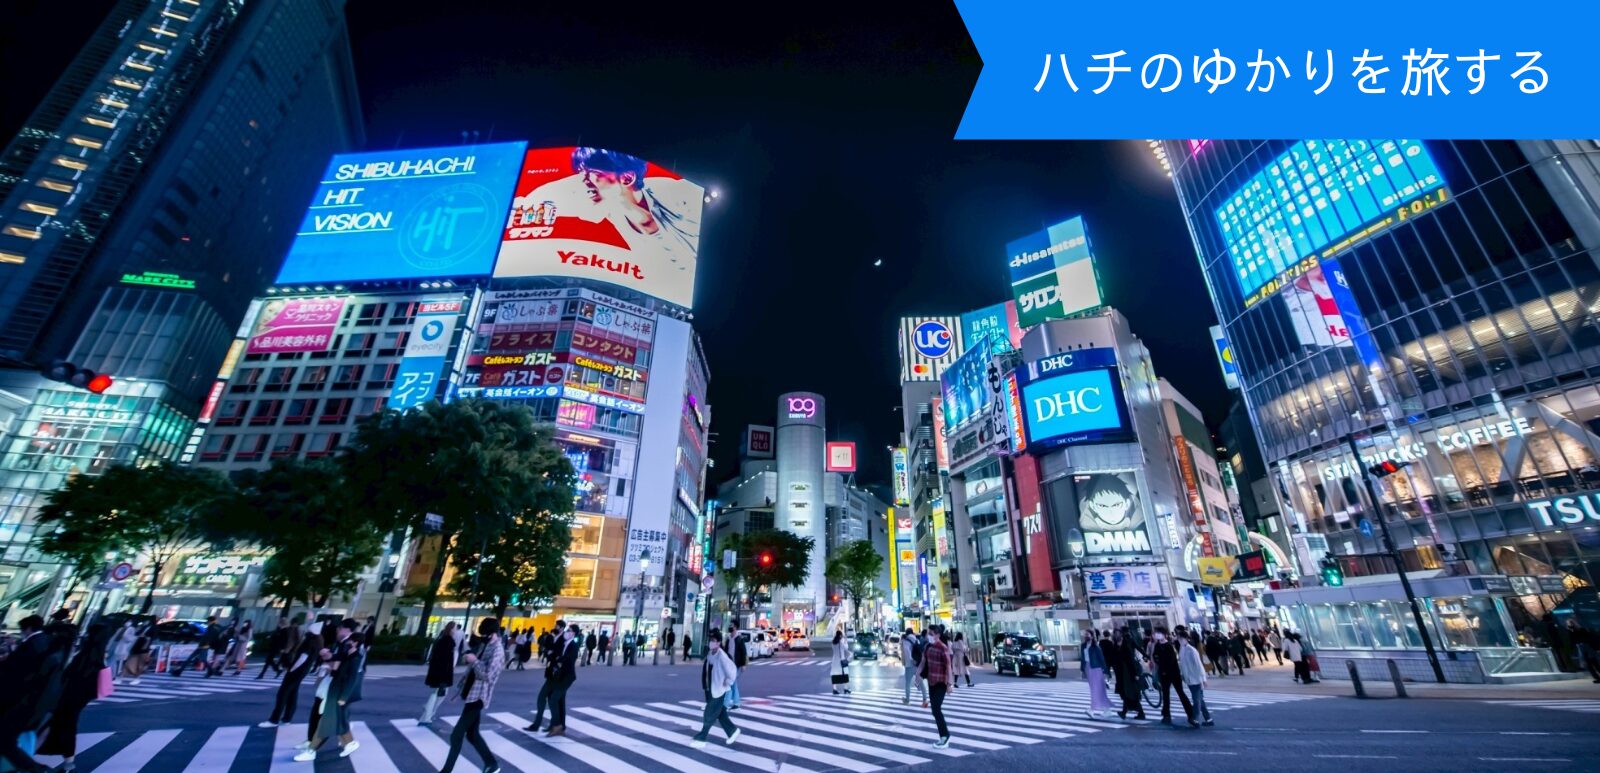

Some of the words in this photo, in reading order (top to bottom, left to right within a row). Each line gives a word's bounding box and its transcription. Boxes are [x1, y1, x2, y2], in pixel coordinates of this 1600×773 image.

[335, 155, 476, 182] SHIBUHACHI
[323, 187, 363, 207] HIT
[313, 211, 393, 233] VISION
[1009, 235, 1086, 267] Hisamitsu
[556, 250, 645, 280] Yakult
[484, 309, 497, 318] 9F
[615, 314, 652, 335] しゃぶ葉
[573, 333, 634, 359] コンタクト
[916, 330, 950, 352] UC
[523, 352, 557, 366] ガスト
[1041, 354, 1074, 373] DHC
[465, 373, 481, 384] 7F
[501, 370, 541, 386] ガスト
[613, 365, 643, 382] ガスト
[788, 397, 816, 418] 109
[1033, 387, 1103, 423] DHC
[752, 432, 768, 442] UNI
[1438, 417, 1533, 452] COFFEE
[631, 528, 667, 543] 広告主募集中
[1084, 531, 1151, 554] DMM
